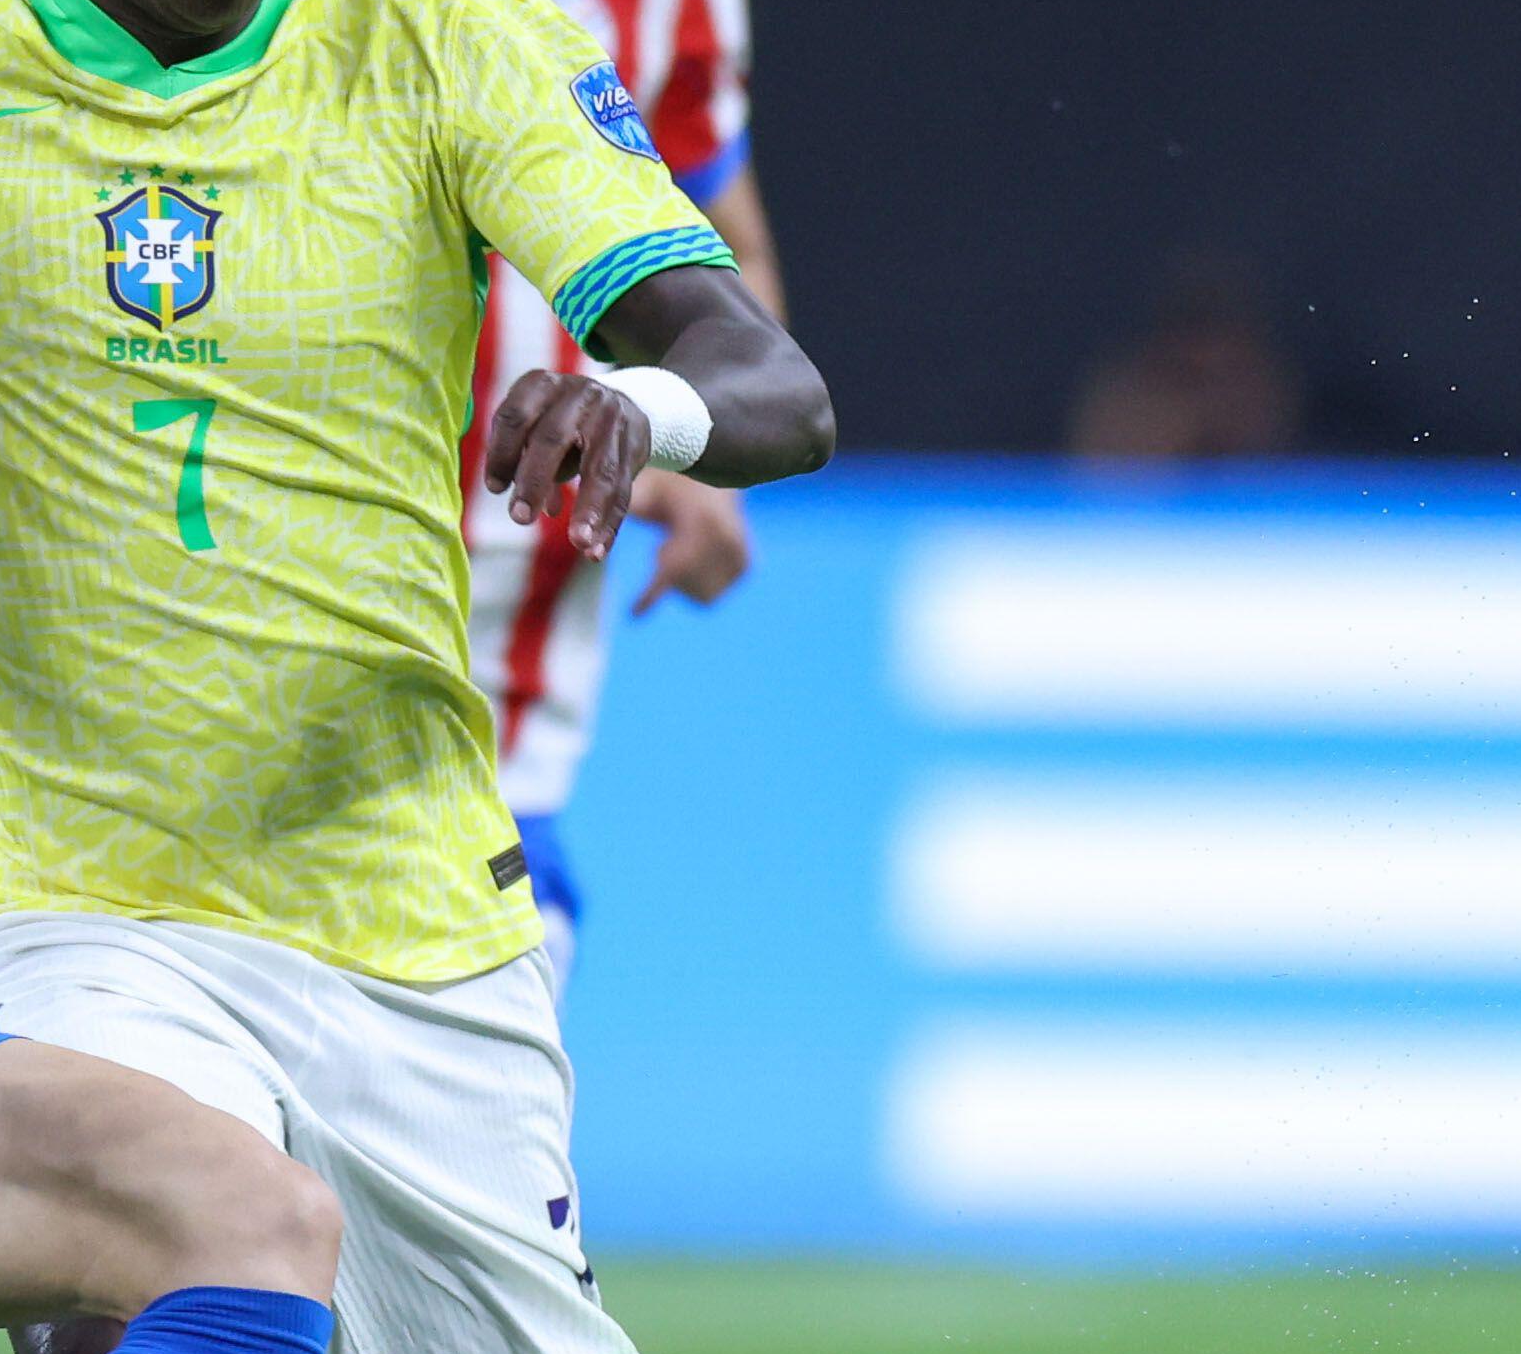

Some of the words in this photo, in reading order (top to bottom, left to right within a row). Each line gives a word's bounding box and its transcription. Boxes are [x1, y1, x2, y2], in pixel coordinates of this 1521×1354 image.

[593, 86, 634, 112] VIB
[611, 106, 637, 119] CONT
[138, 243, 181, 260] CBF
[106, 337, 228, 364] BRASIL
[132, 398, 219, 552] 7
